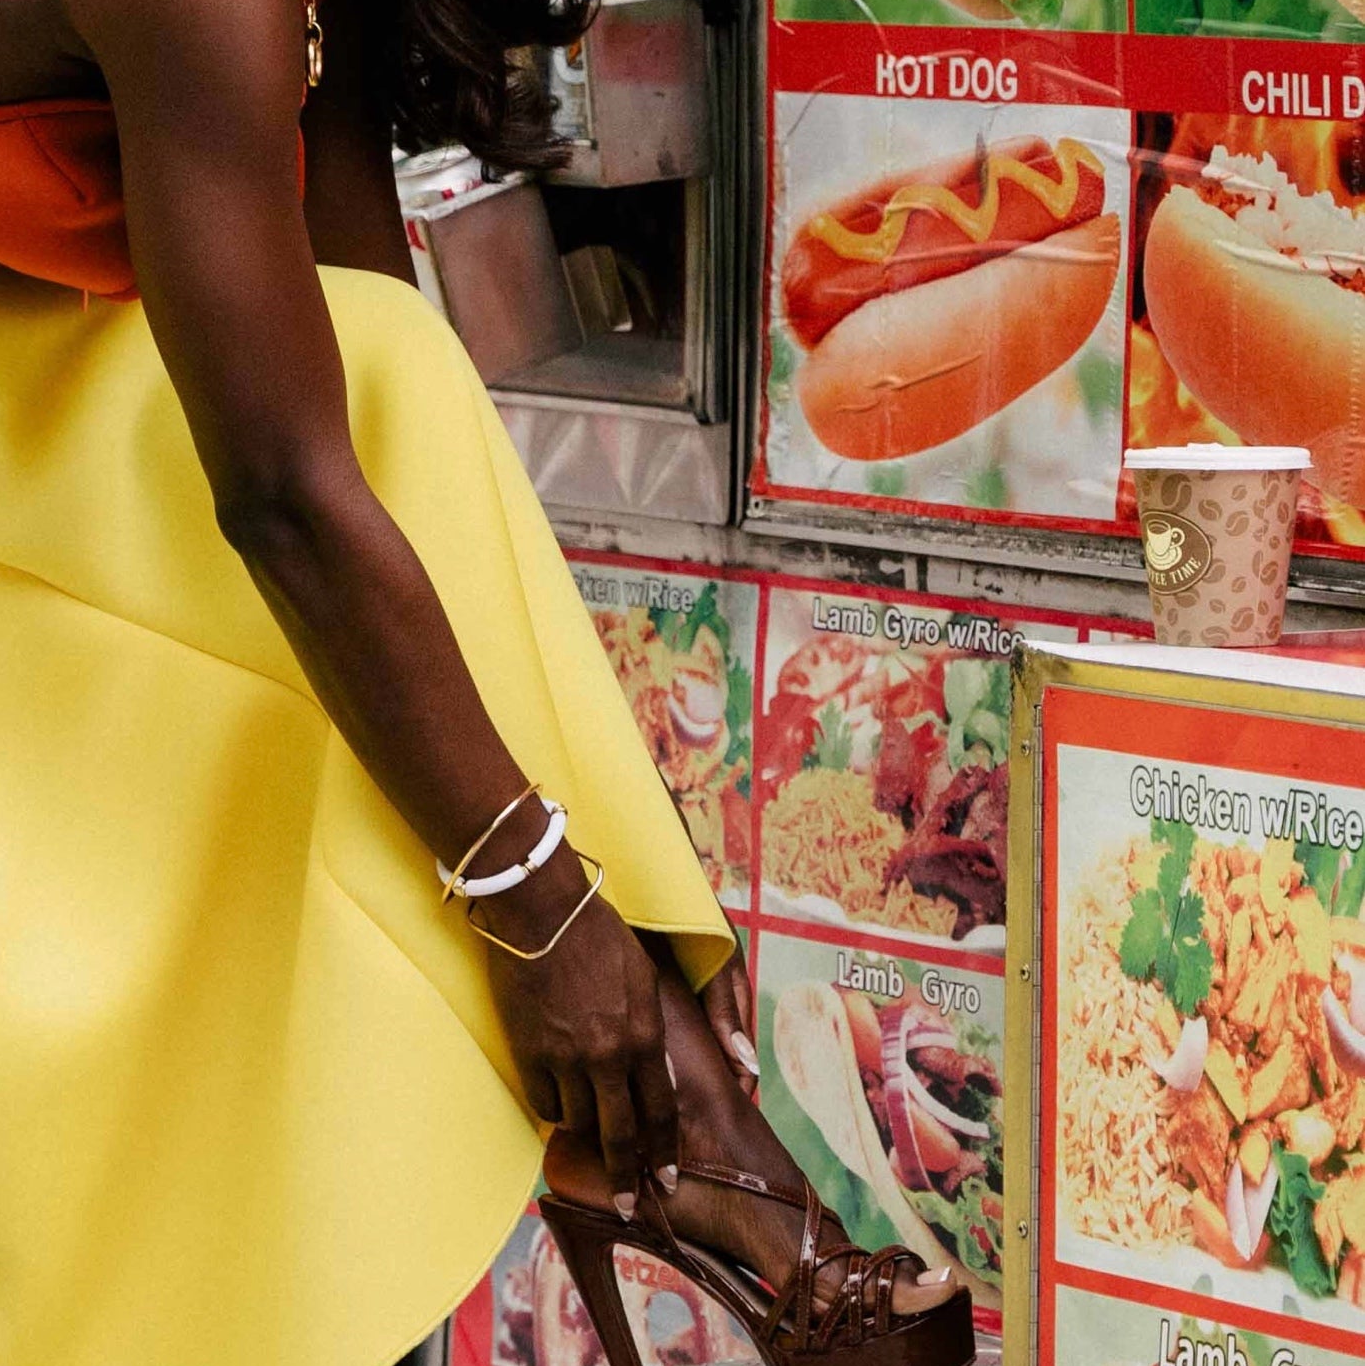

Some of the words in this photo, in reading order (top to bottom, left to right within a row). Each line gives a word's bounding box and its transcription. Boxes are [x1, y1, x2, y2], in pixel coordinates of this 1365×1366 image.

[875, 53, 940, 96] HOT
[949, 57, 1018, 101] DOG
[1242, 70, 1331, 117] CHILI
[1169, 557, 1202, 584] TIME
[813, 596, 877, 636] Lamb
[883, 605, 941, 649] Gyro
[1130, 765, 1251, 834] Chicken
[1259, 788, 1364, 853] w/Rice
[837, 952, 904, 998] Lamb
[921, 969, 981, 1016] Gyro
